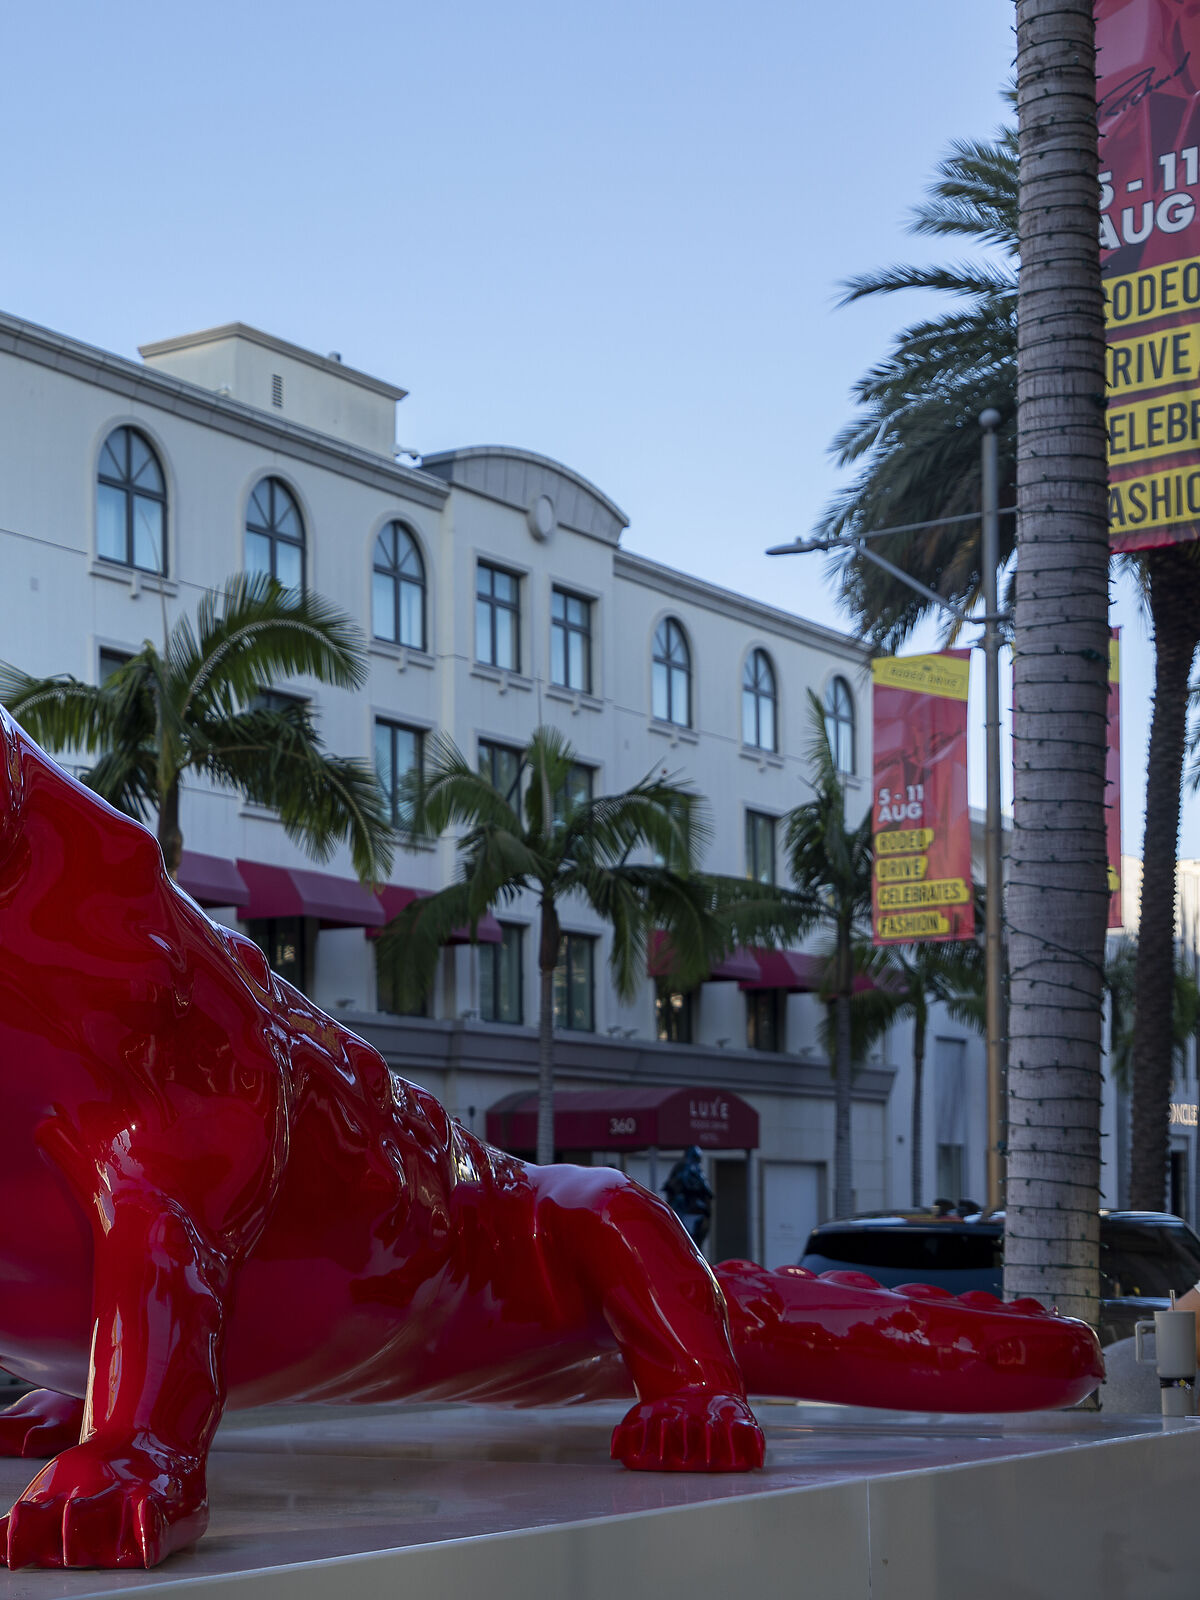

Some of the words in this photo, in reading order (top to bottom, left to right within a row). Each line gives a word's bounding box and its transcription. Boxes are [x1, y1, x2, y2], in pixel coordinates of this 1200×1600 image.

[1159, 146, 1198, 192] 11
[1098, 192, 1196, 250] AUG
[1102, 263, 1200, 321] ODEO
[1112, 332, 1191, 388] RIVE
[878, 787, 891, 805] 5
[906, 783, 924, 802] 11
[878, 801, 923, 823] AUG
[880, 830, 926, 851] RODEO
[880, 858, 921, 878] DRIVE
[881, 882, 960, 905] CELEBRATES
[880, 914, 938, 936] FASHION
[609, 1117, 636, 1135] 360
